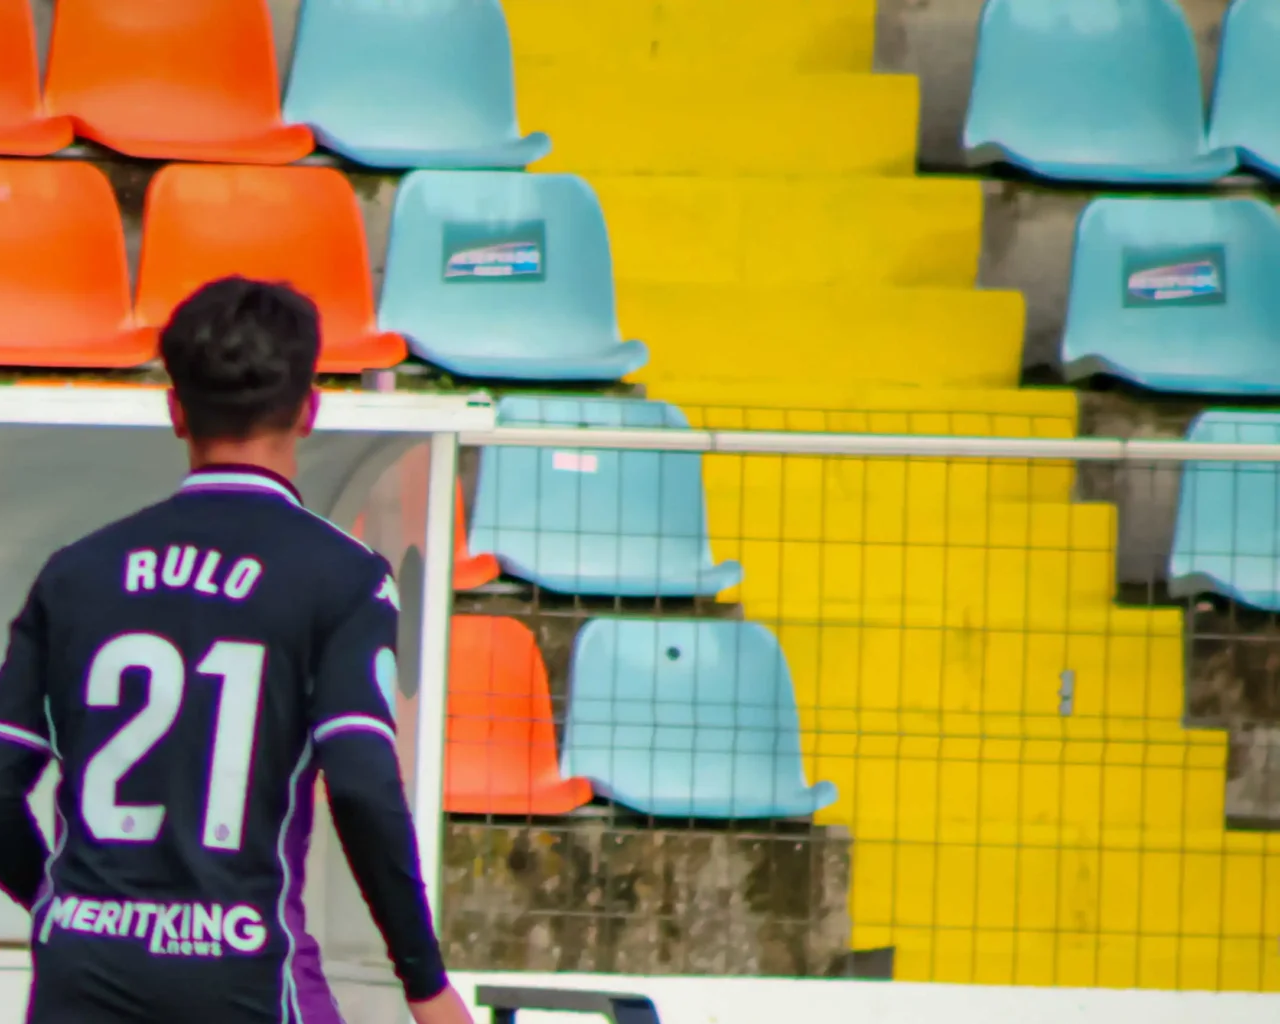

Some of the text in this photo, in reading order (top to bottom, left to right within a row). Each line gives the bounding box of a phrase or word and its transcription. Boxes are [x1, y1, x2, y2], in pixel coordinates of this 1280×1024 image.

[125, 545, 262, 599] RULO
[81, 632, 266, 850] 21
[38, 896, 267, 954] MERITKING
